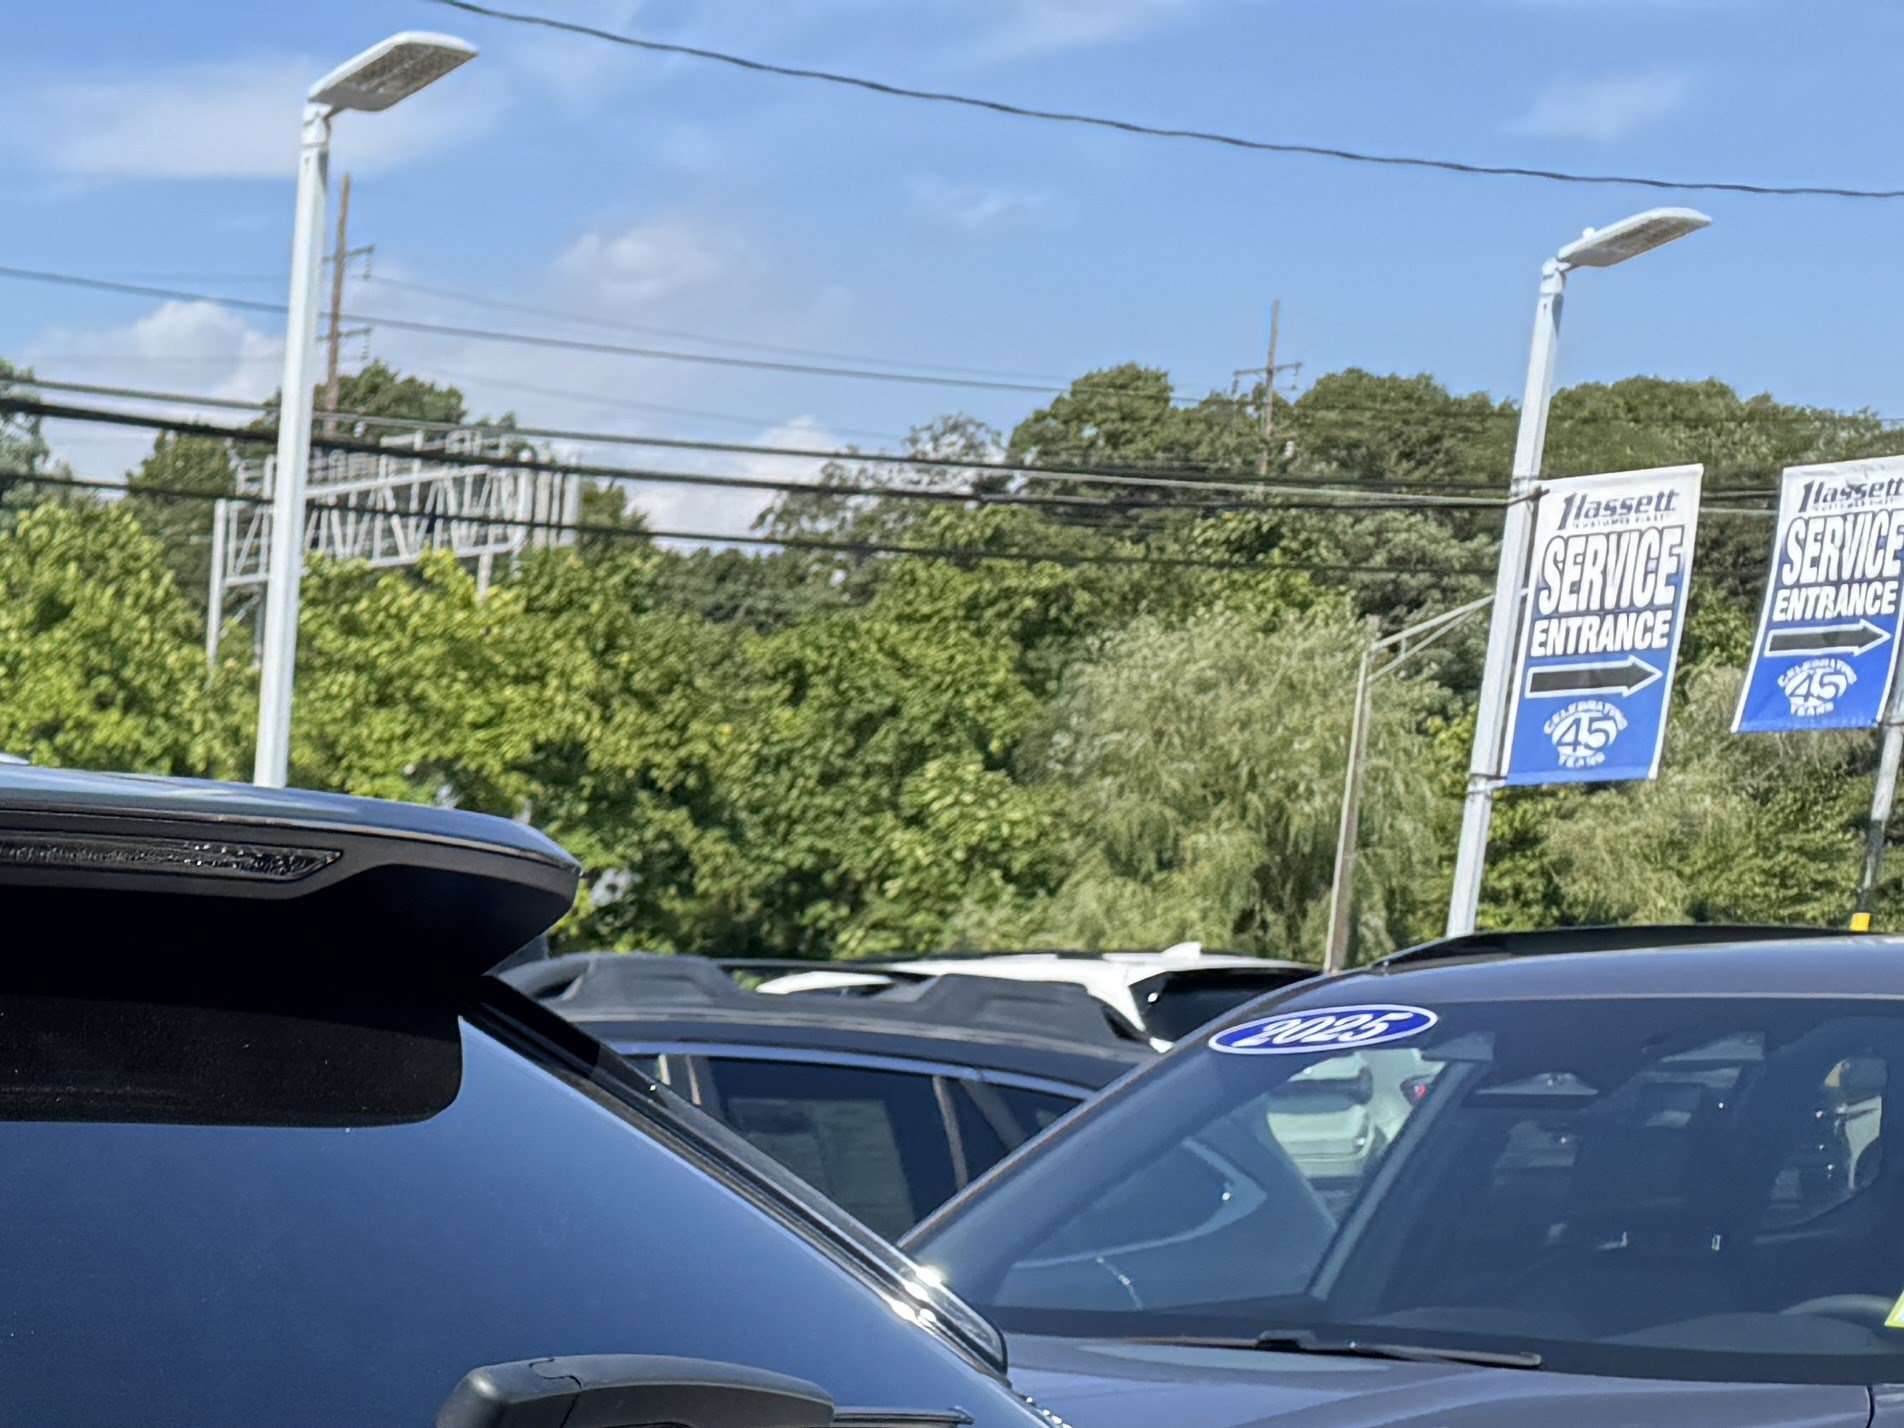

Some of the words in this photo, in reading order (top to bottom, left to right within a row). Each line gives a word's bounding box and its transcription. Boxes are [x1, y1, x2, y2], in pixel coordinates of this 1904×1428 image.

[1782, 508, 1904, 585] SERVICE
[1538, 526, 1685, 615] SERVICE
[1772, 580, 1899, 622] ENTRANCE
[1530, 610, 1672, 657] ENTRANCE
[1789, 671, 1840, 702] 45
[1555, 716, 1610, 752] 45
[1232, 1012, 1414, 1047] 2025
